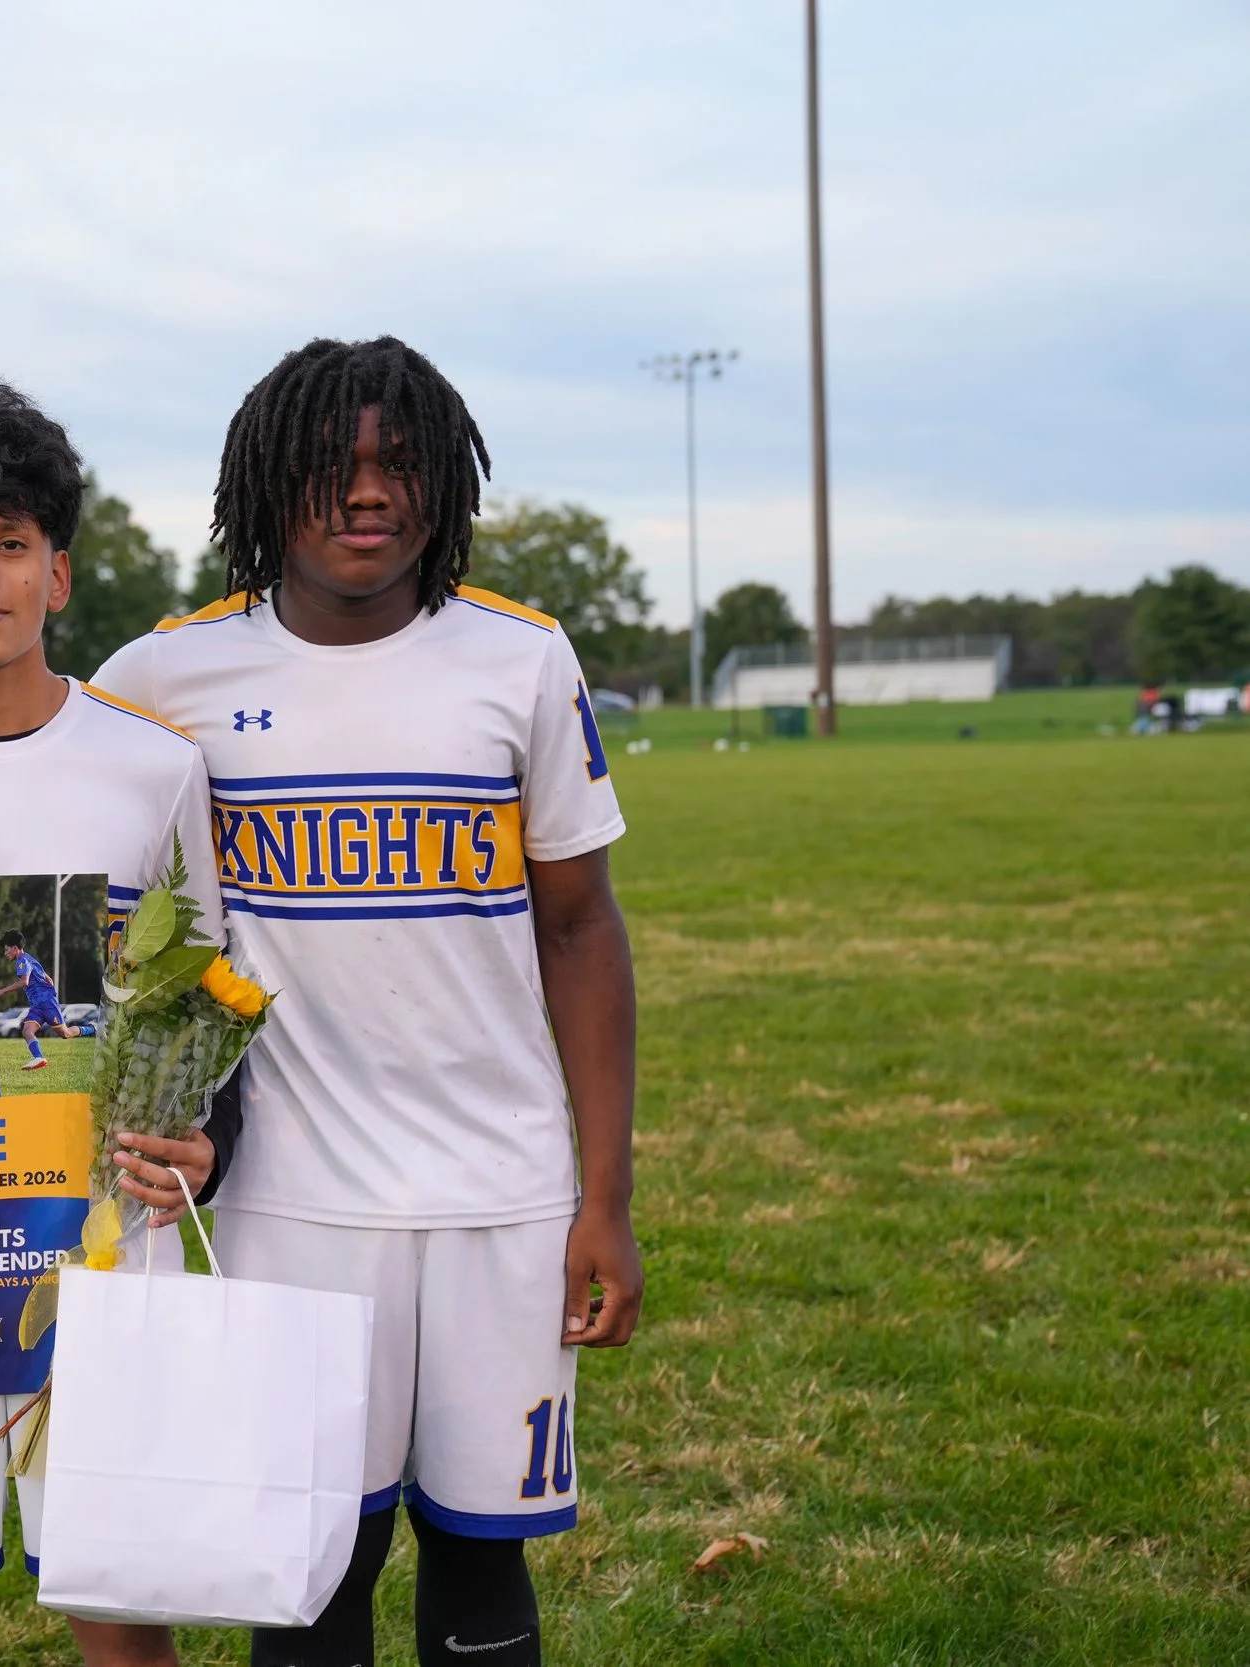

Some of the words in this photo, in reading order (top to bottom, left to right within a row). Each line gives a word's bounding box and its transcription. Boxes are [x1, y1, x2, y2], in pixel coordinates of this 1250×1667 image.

[213, 807, 496, 887] KNIGHTS
[24, 1170, 66, 1186] 2026
[0, 1250, 69, 1271] ENDED
[21, 1276, 30, 1286] A
[32, 1274, 59, 1285] KNIG
[519, 1390, 572, 1501] 10
